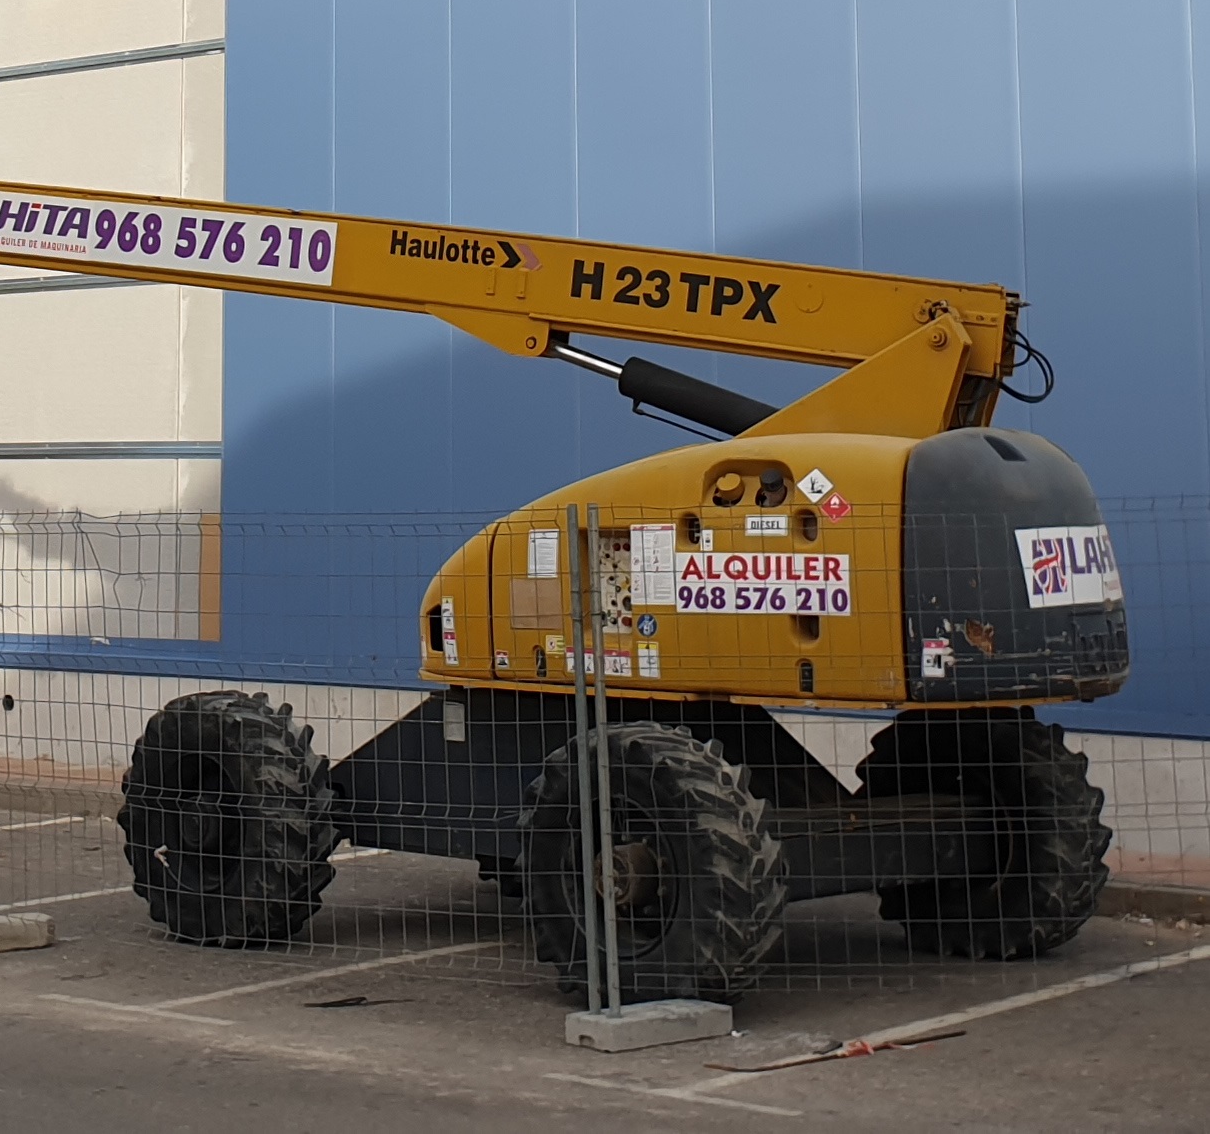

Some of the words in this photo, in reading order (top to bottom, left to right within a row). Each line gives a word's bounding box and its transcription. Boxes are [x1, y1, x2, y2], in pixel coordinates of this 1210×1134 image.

[28, 239, 38, 249] DE
[40, 240, 87, 254] MAQUINARIA
[94, 208, 162, 255] 968
[174, 216, 246, 263] 576
[257, 224, 331, 272] 210
[390, 229, 496, 266] Haulotte
[570, 259, 605, 300] H
[613, 266, 671, 308] 23
[680, 272, 781, 324] TPX
[750, 520, 781, 530] DIESEL
[681, 555, 843, 582] ALQUILER
[678, 585, 726, 610] 968
[735, 587, 786, 611] 576
[796, 587, 848, 612] 210
